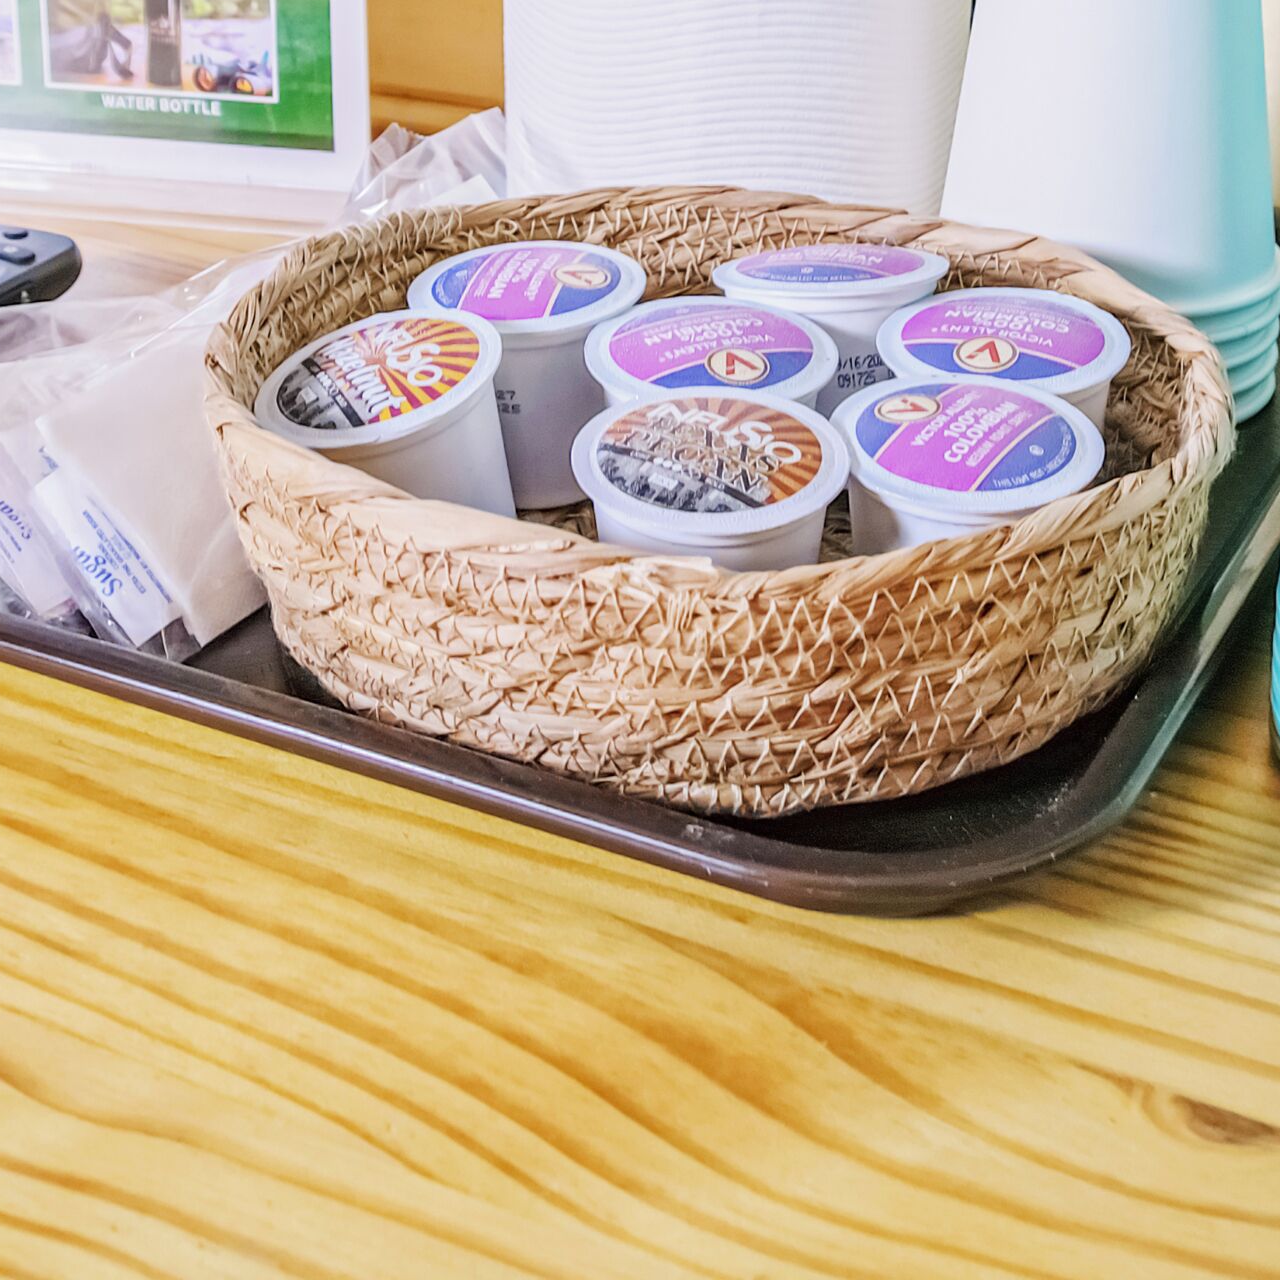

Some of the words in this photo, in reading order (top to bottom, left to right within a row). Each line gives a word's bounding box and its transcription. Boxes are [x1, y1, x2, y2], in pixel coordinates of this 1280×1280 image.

[101, 93, 156, 111] WATER
[159, 97, 221, 117] BOTTLE
[944, 309, 1070, 334] COLOMBIAN
[998, 330, 1053, 348] VICTOR
[943, 407, 988, 437] 100%
[944, 401, 1019, 463] COLOMBIAN
